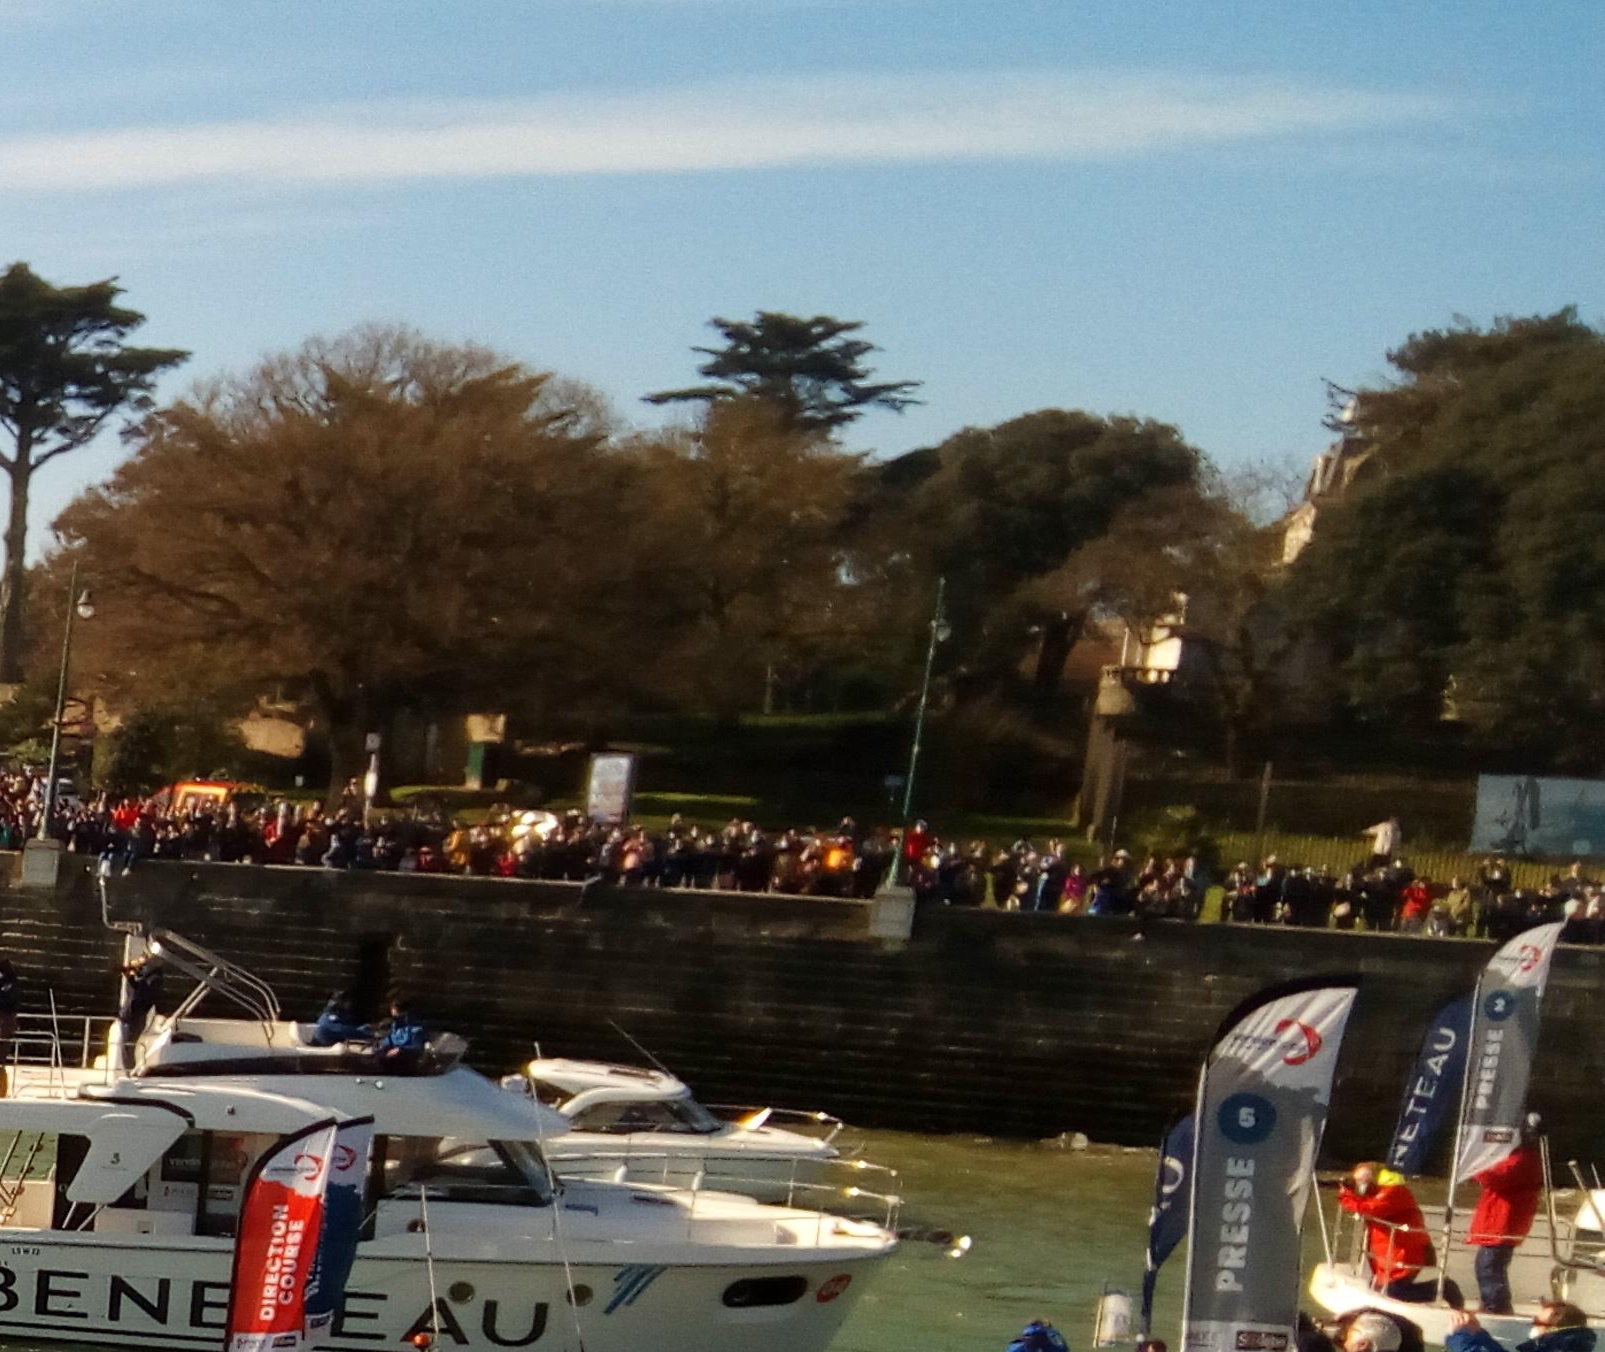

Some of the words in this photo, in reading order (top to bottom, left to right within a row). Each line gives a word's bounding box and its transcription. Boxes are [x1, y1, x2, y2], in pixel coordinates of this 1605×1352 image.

[1475, 1029, 1503, 1110] PRESSE
[259, 1204, 289, 1322] DIRECTION
[277, 1219, 305, 1305] COURSE
[1215, 1156, 1256, 1292] PRESSE
